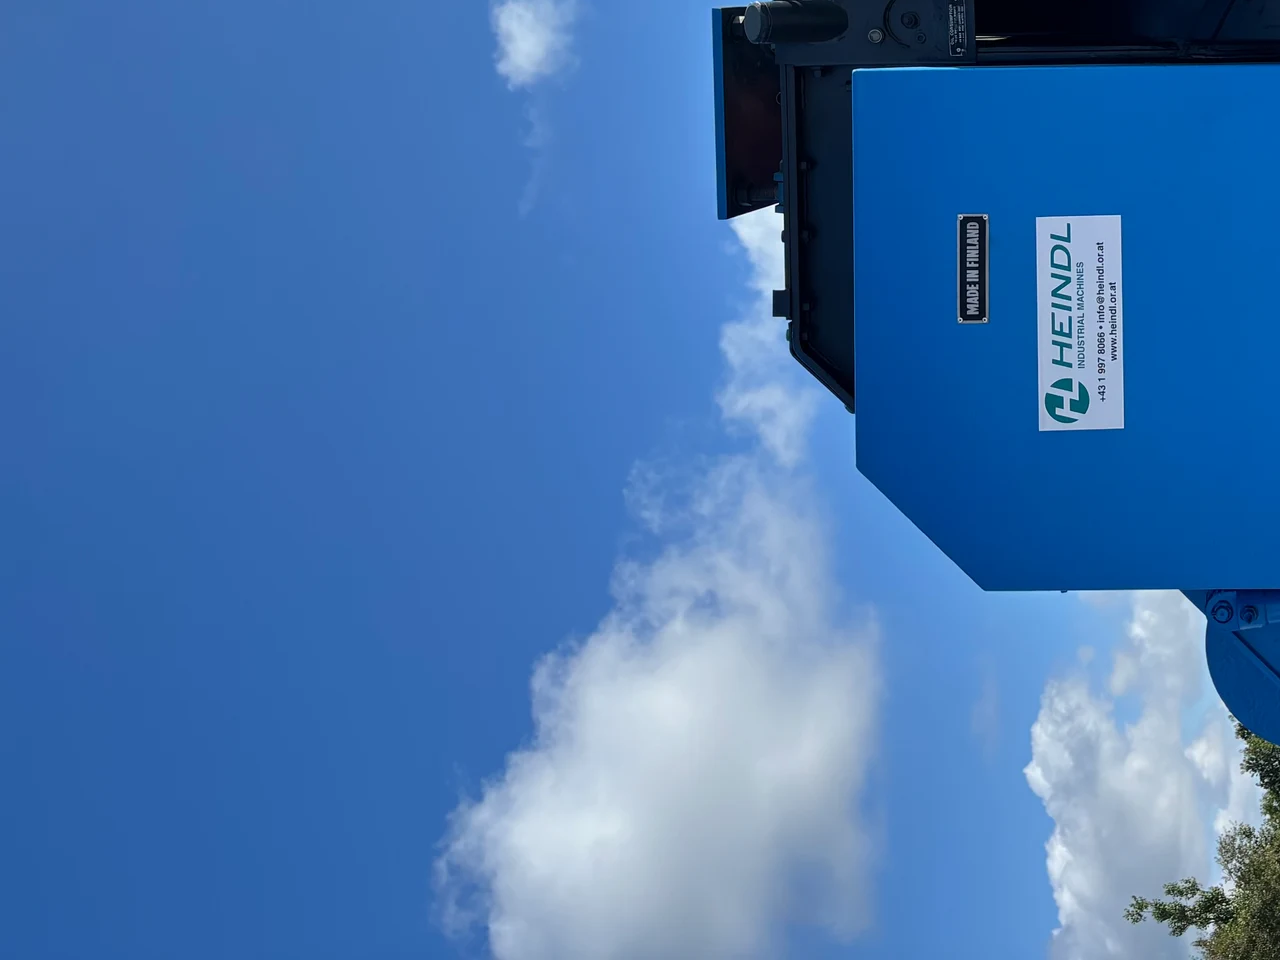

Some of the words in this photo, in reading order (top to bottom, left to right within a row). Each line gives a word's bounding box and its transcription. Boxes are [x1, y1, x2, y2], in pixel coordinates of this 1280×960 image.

[966, 222, 979, 267] FINLAND
[966, 270, 979, 282] IN
[1050, 223, 1073, 368] HEINDL
[1076, 262, 1084, 310] MACHINES
[1096, 242, 1105, 323] info@heindl.or.at
[966, 284, 979, 315] MADE
[1109, 282, 1117, 361] www.heindl.or.at
[1077, 313, 1085, 369] INDUSTRIAL
[1097, 332, 1105, 354] 8066
[1098, 385, 1106, 402] +43
